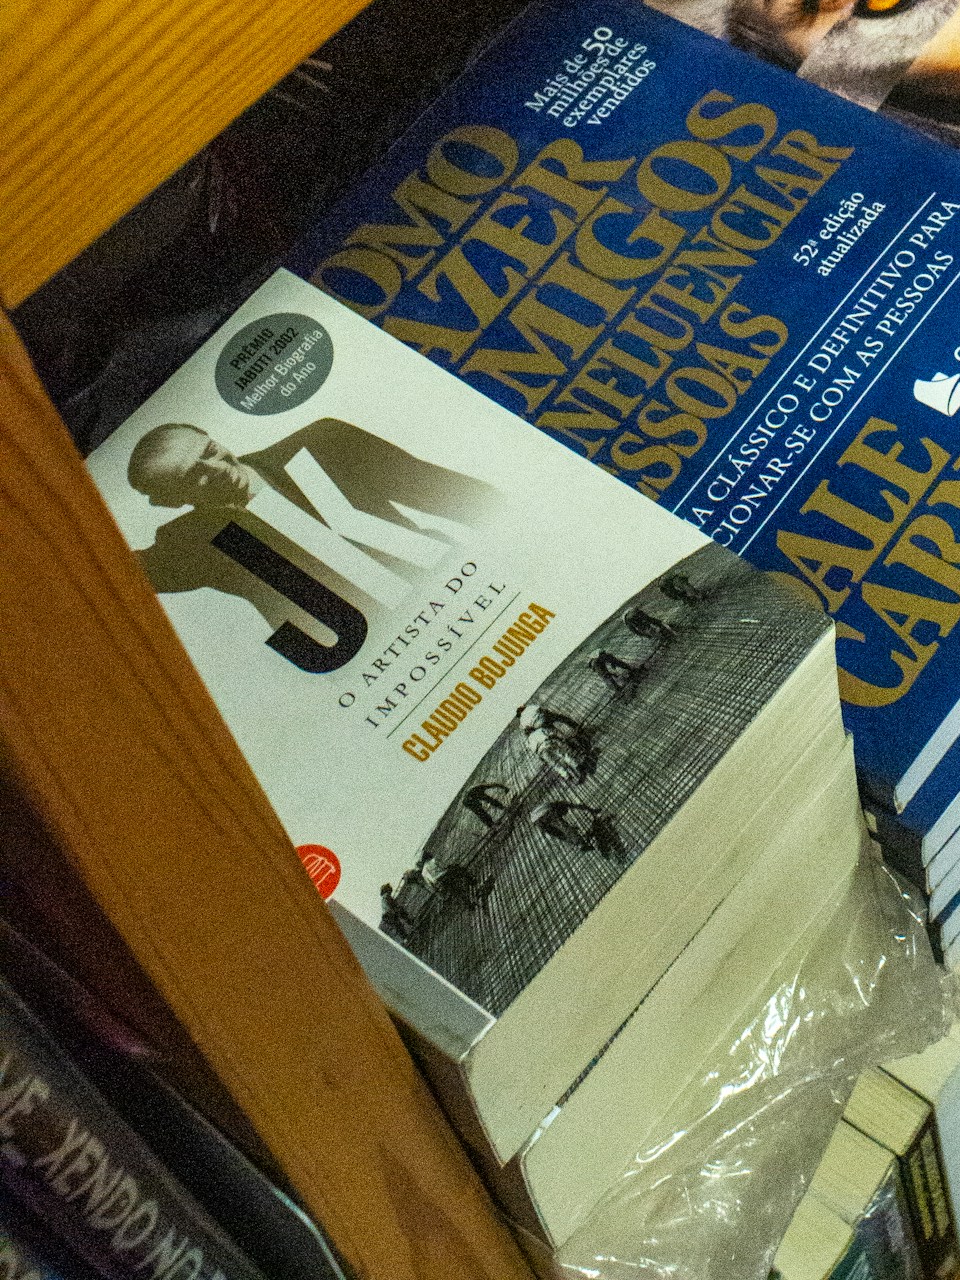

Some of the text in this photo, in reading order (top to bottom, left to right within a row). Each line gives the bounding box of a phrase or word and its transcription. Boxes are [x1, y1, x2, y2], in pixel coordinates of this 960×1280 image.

[524, 26, 613, 112] Mais de 50
[547, 37, 628, 118] milhões de
[563, 43, 647, 127] exemplares
[587, 59, 657, 125] vendidos
[308, 124, 520, 321] OMO
[459, 89, 778, 412] MIGOS
[817, 200, 886, 278] atualizada
[818, 190, 865, 241] edição
[230, 327, 275, 371] PRÊMIO
[234, 326, 299, 392] JABUTI 2002
[536, 129, 855, 459] NFLUENCIAR
[240, 328, 323, 410] Melhor Biografia
[280, 361, 317, 398] do Ano
[600, 302, 789, 502] SSOAS
[707, 392, 800, 502] CLÁSSICO
[792, 373, 817, 393] E
[808, 250, 916, 374] DEFINITIVO
[711, 250, 954, 548] CIONAR-SE COM AS PESSOAS
[768, 416, 951, 613] ALE
[211, 521, 369, 674] J
[338, 561, 478, 709] O ARTISTA DO
[364, 581, 506, 730] IMPOSSÍVEL
[401, 602, 556, 762] CLAUDIO BOJUNGA
